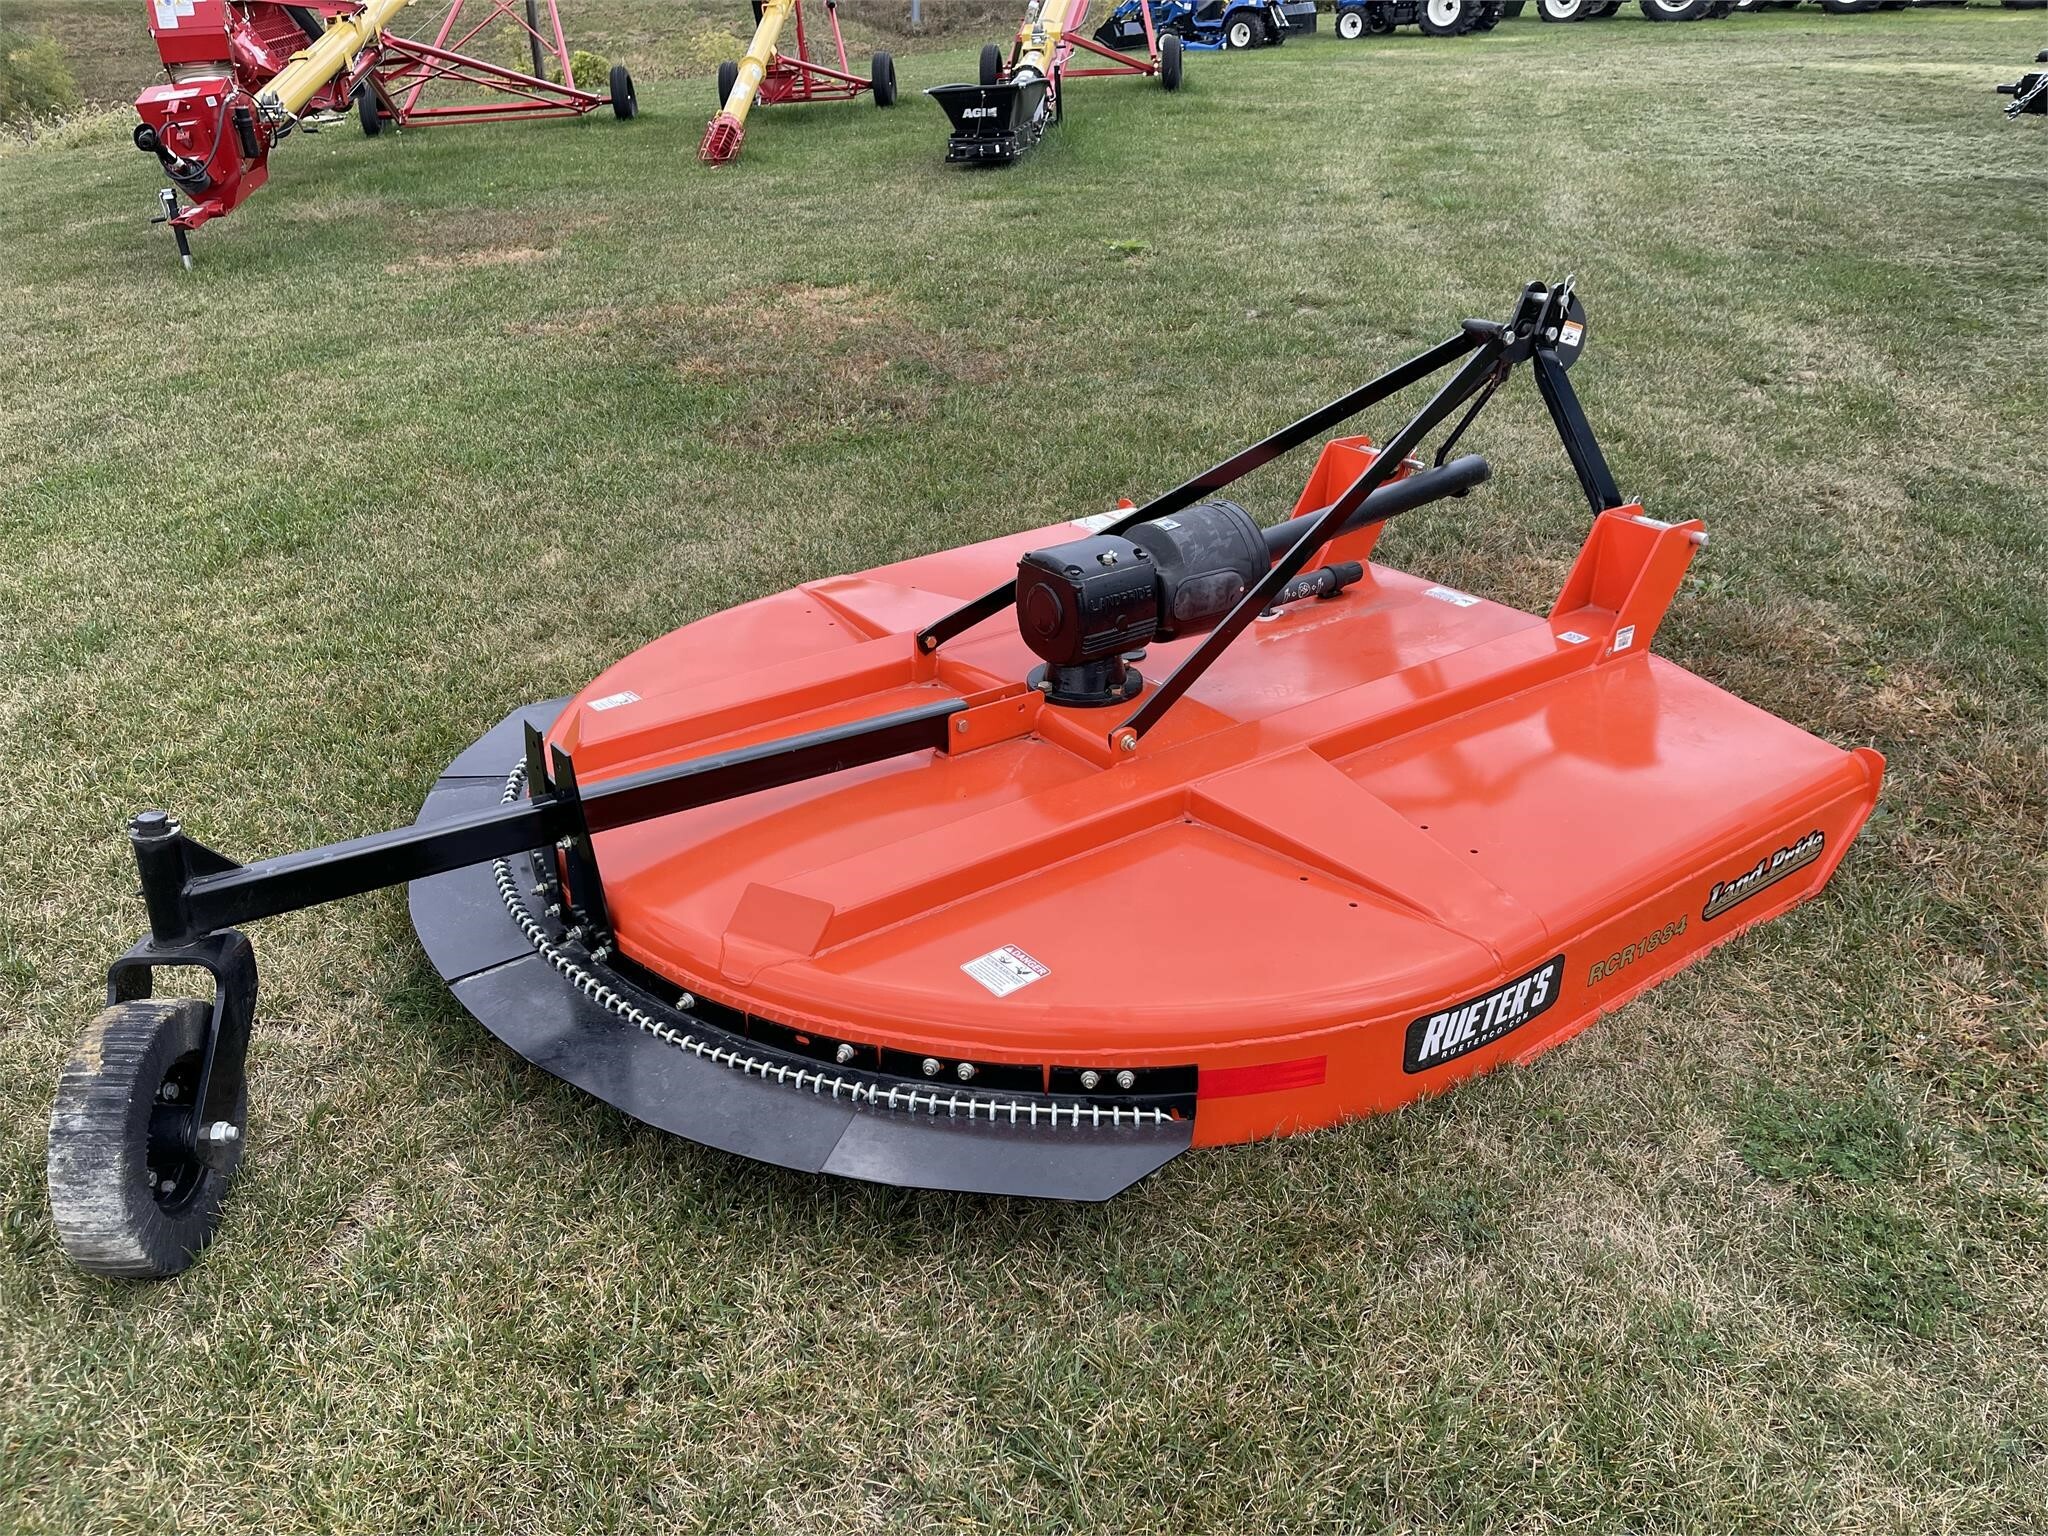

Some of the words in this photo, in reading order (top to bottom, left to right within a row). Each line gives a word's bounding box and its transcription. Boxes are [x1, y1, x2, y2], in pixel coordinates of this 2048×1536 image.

[962, 107, 986, 118] AGI
[1705, 859, 1767, 910] Land
[1769, 831, 1824, 878] Pride
[1013, 949, 1047, 975] DANGER
[1587, 914, 1689, 987] RCR1884
[1417, 964, 1555, 1063] RUETER'S
[1440, 1011, 1530, 1059] RUETERCO.COM
